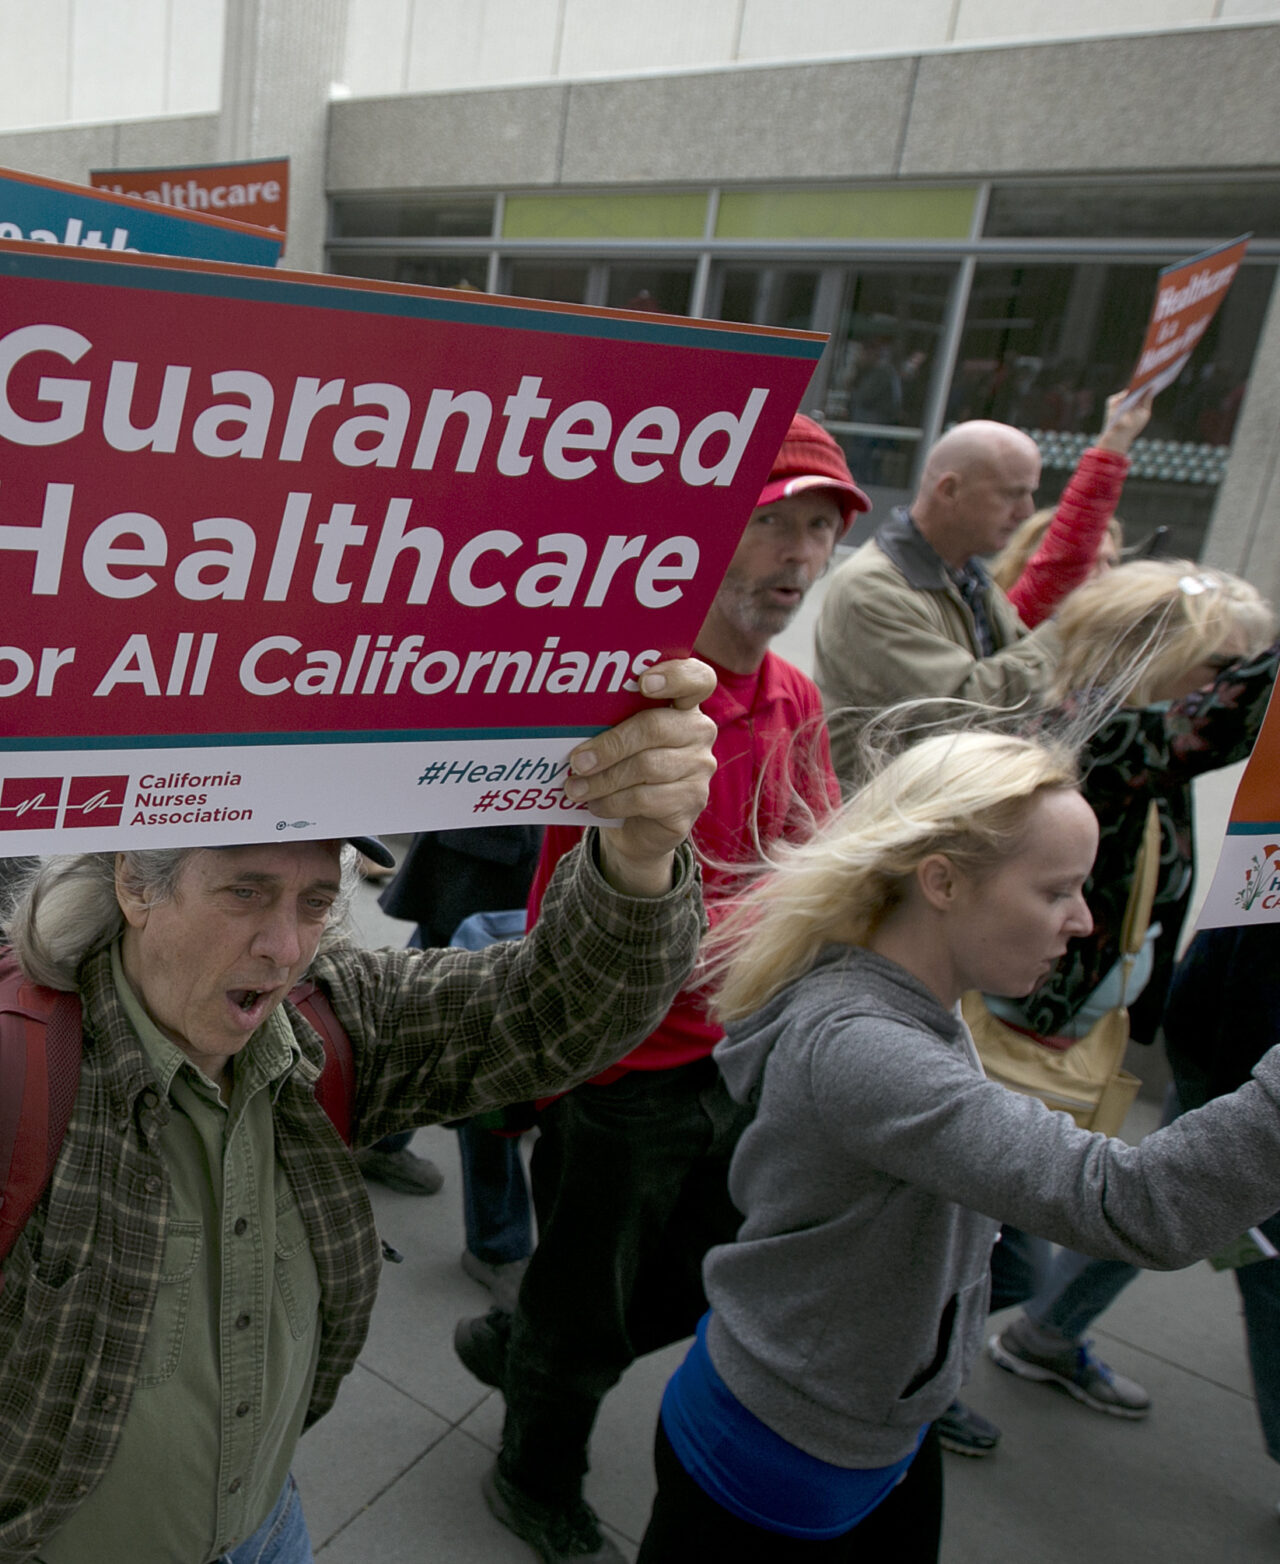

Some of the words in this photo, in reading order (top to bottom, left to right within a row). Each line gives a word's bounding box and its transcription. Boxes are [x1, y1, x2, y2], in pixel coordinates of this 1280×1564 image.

[95, 632, 218, 696] All
[239, 633, 659, 696] Californians
[139, 771, 242, 790] California
[417, 757, 574, 785] #Healthy
[135, 792, 207, 807] Nurses
[130, 807, 253, 826] Association
